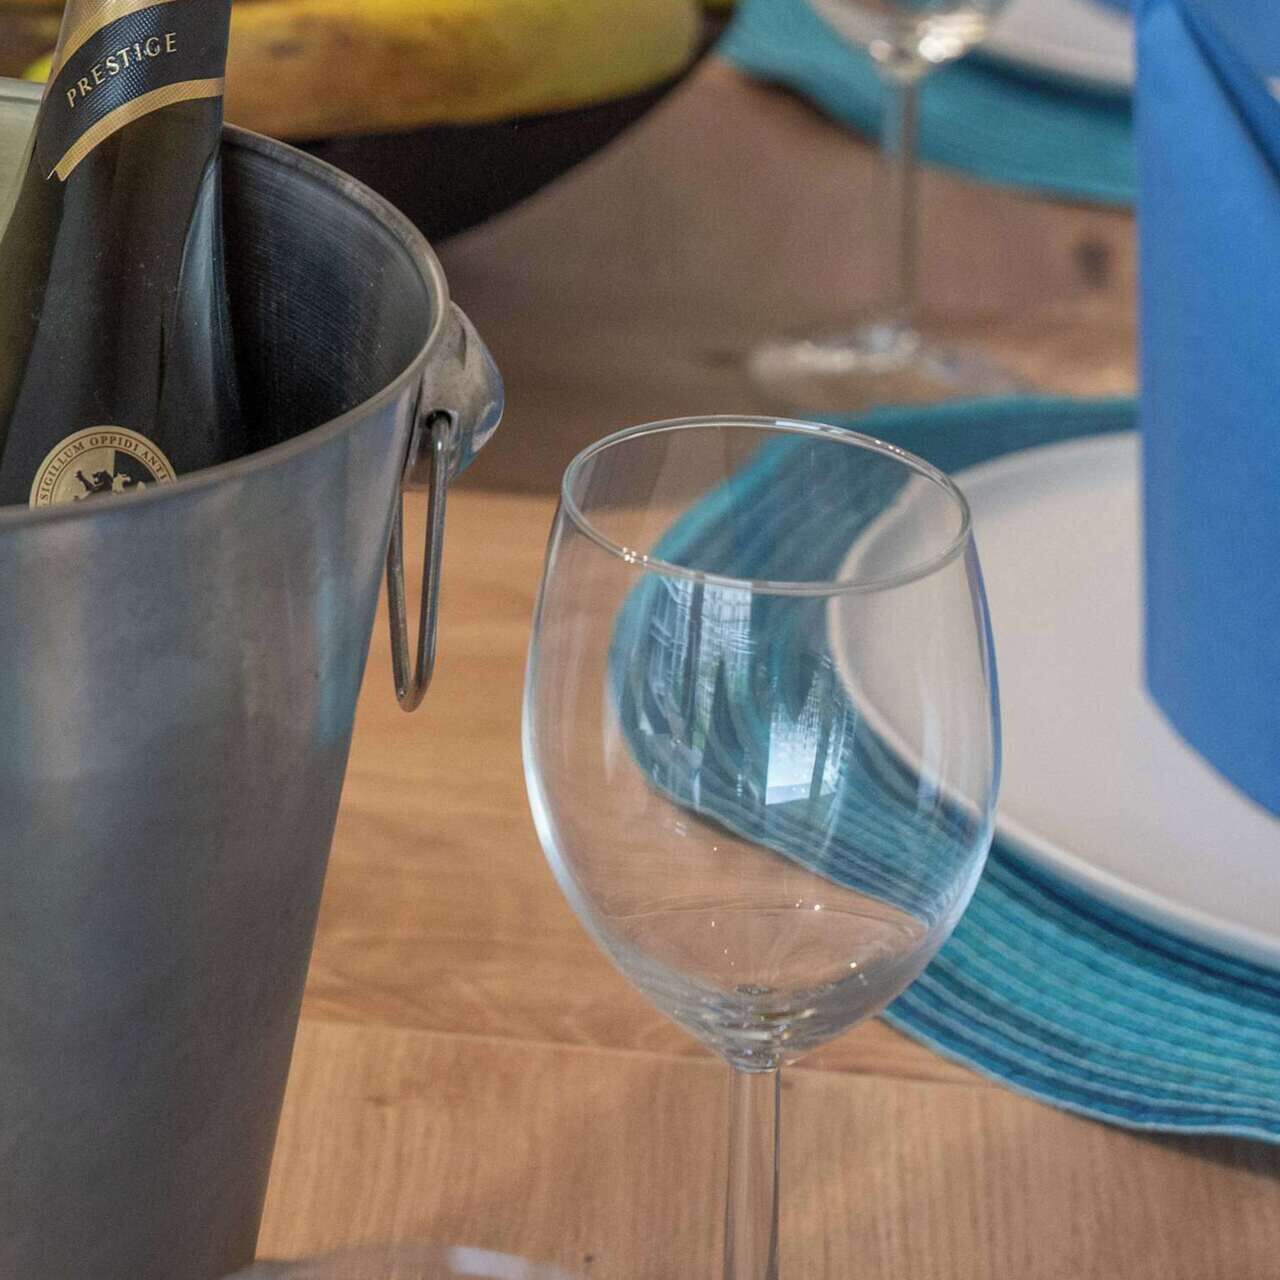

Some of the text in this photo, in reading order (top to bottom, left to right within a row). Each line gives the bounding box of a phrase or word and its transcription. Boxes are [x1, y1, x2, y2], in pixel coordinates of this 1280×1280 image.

[65, 32, 177, 109] PRESTIGE
[39, 435, 169, 501] SIGILLUM OPPIDI ANTI
